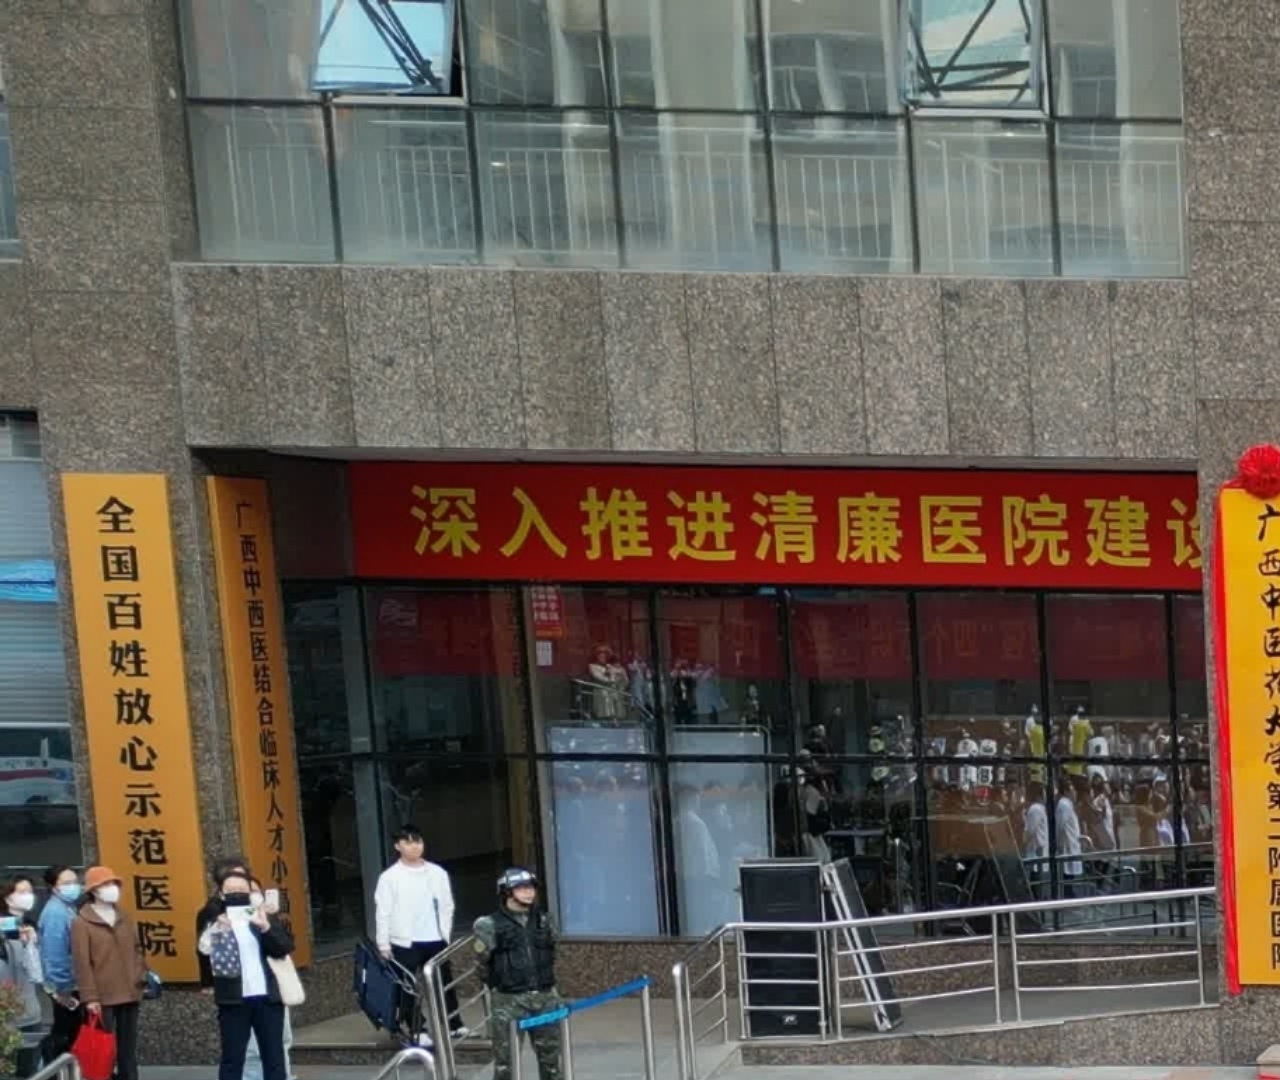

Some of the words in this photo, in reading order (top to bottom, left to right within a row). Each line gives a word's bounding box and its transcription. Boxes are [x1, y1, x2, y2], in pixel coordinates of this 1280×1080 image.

[97, 497, 178, 958] 全国百姓放心示范医院
